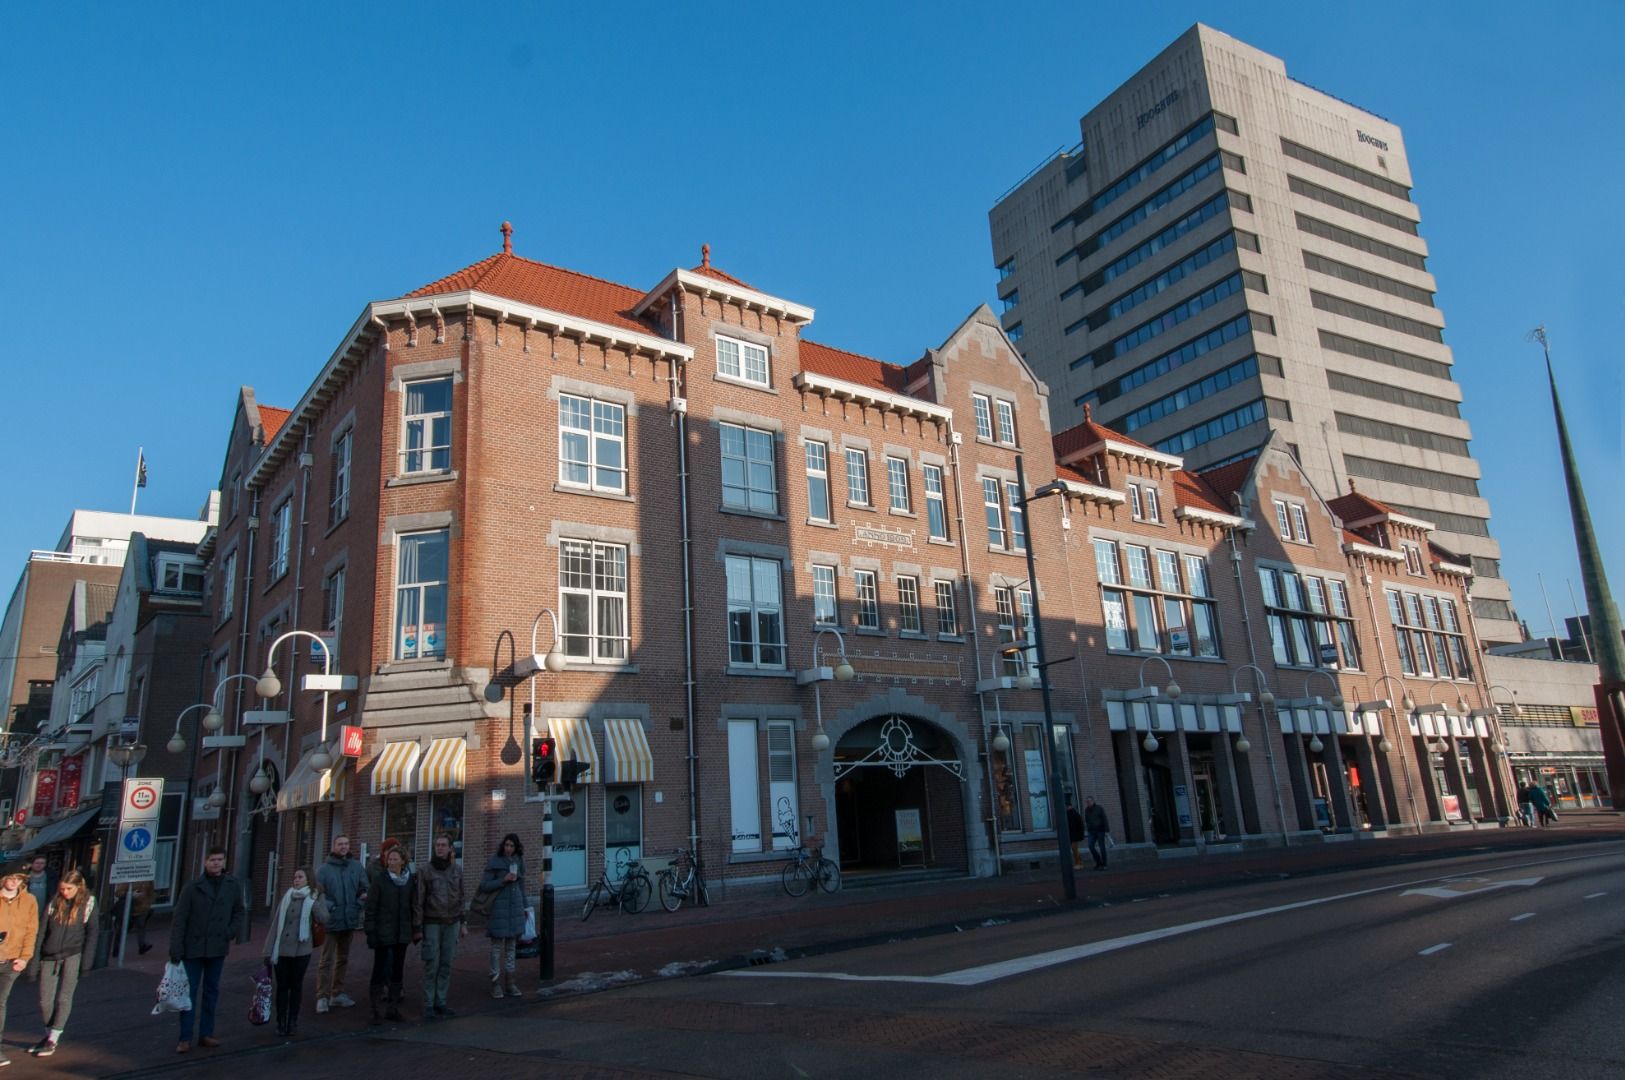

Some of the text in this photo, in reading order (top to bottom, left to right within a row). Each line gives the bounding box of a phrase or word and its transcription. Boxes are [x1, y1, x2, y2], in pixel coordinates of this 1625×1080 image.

[1136, 90, 1178, 130] HOOGHUIS
[1356, 128, 1389, 152] HOOGHUIS
[348, 732, 362, 754] illy
